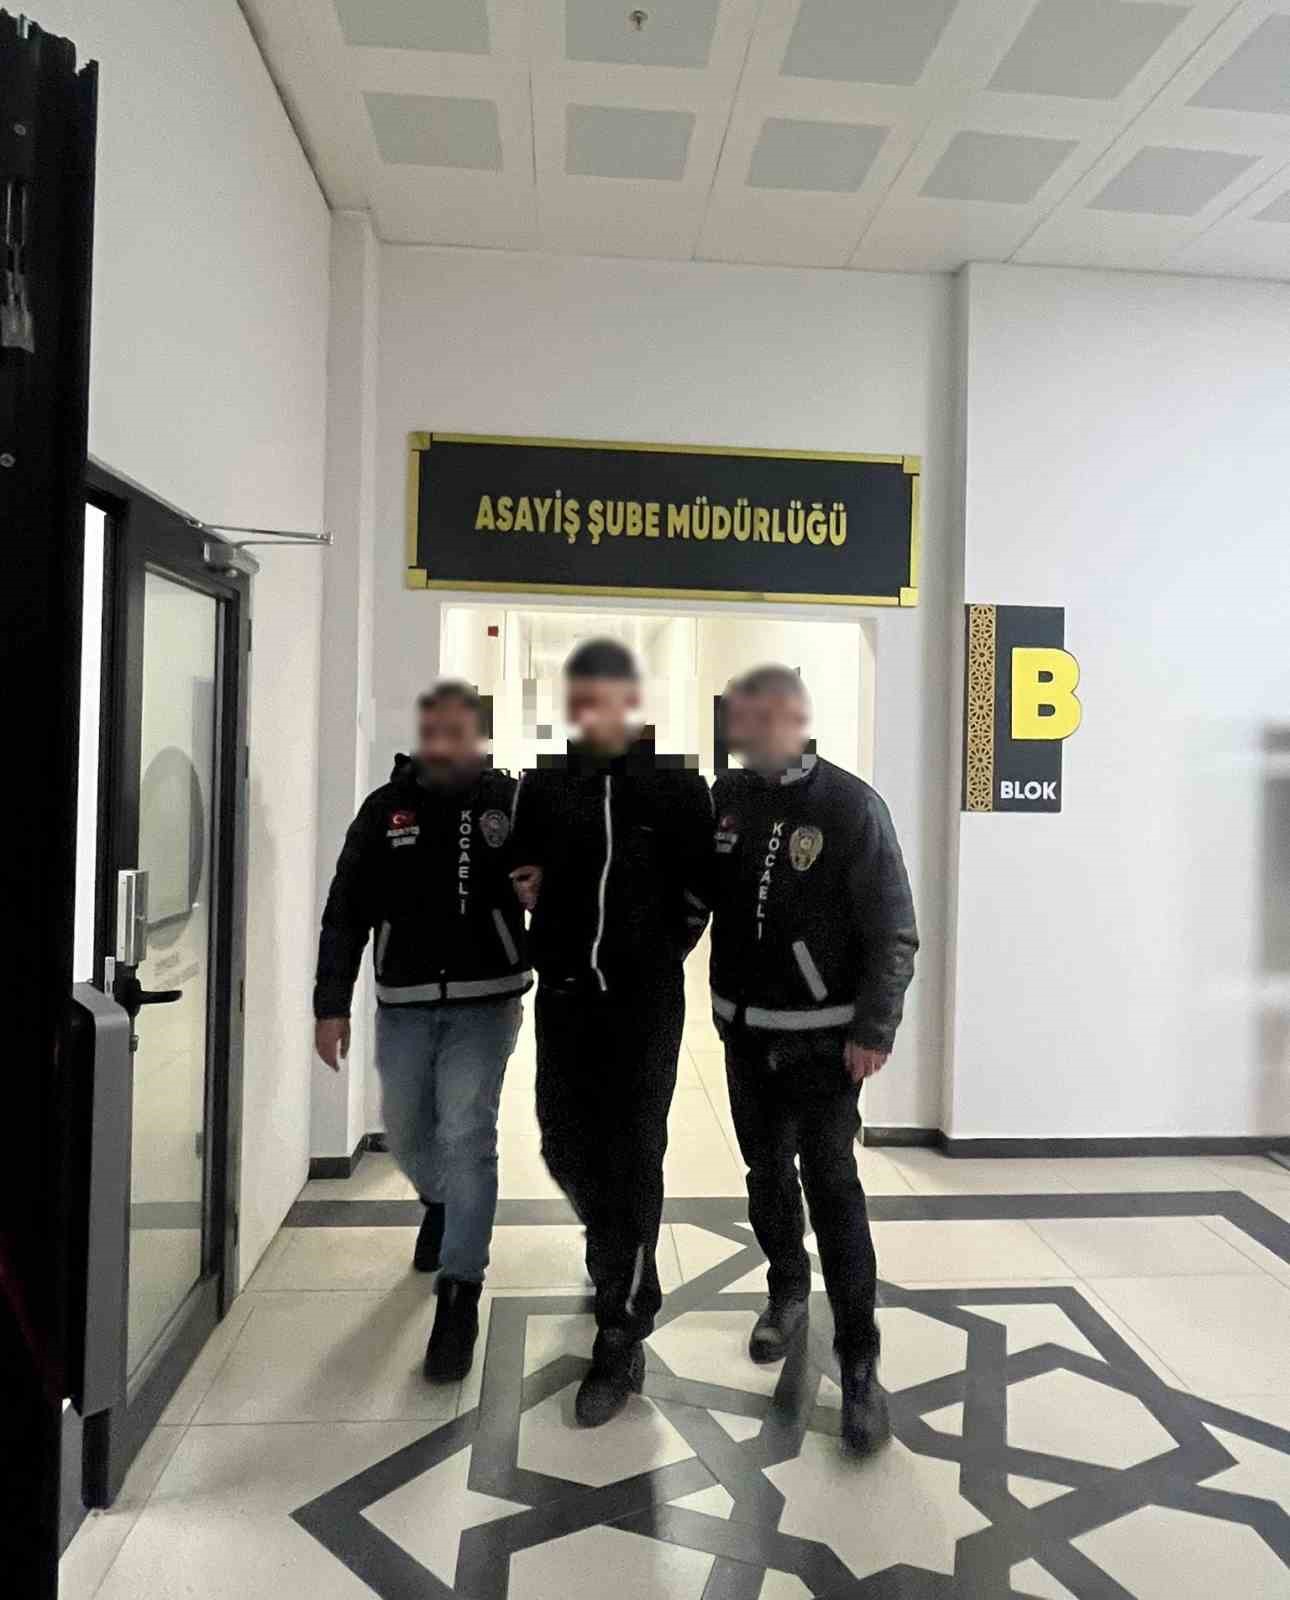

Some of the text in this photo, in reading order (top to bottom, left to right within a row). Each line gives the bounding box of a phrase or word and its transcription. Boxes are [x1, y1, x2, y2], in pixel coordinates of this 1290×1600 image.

[475, 489, 848, 546] ASAYİŞ ŞUBE MÜDÜRLÜĞÜ
[1011, 647, 1082, 740] B
[1000, 781, 1057, 800] BLOK
